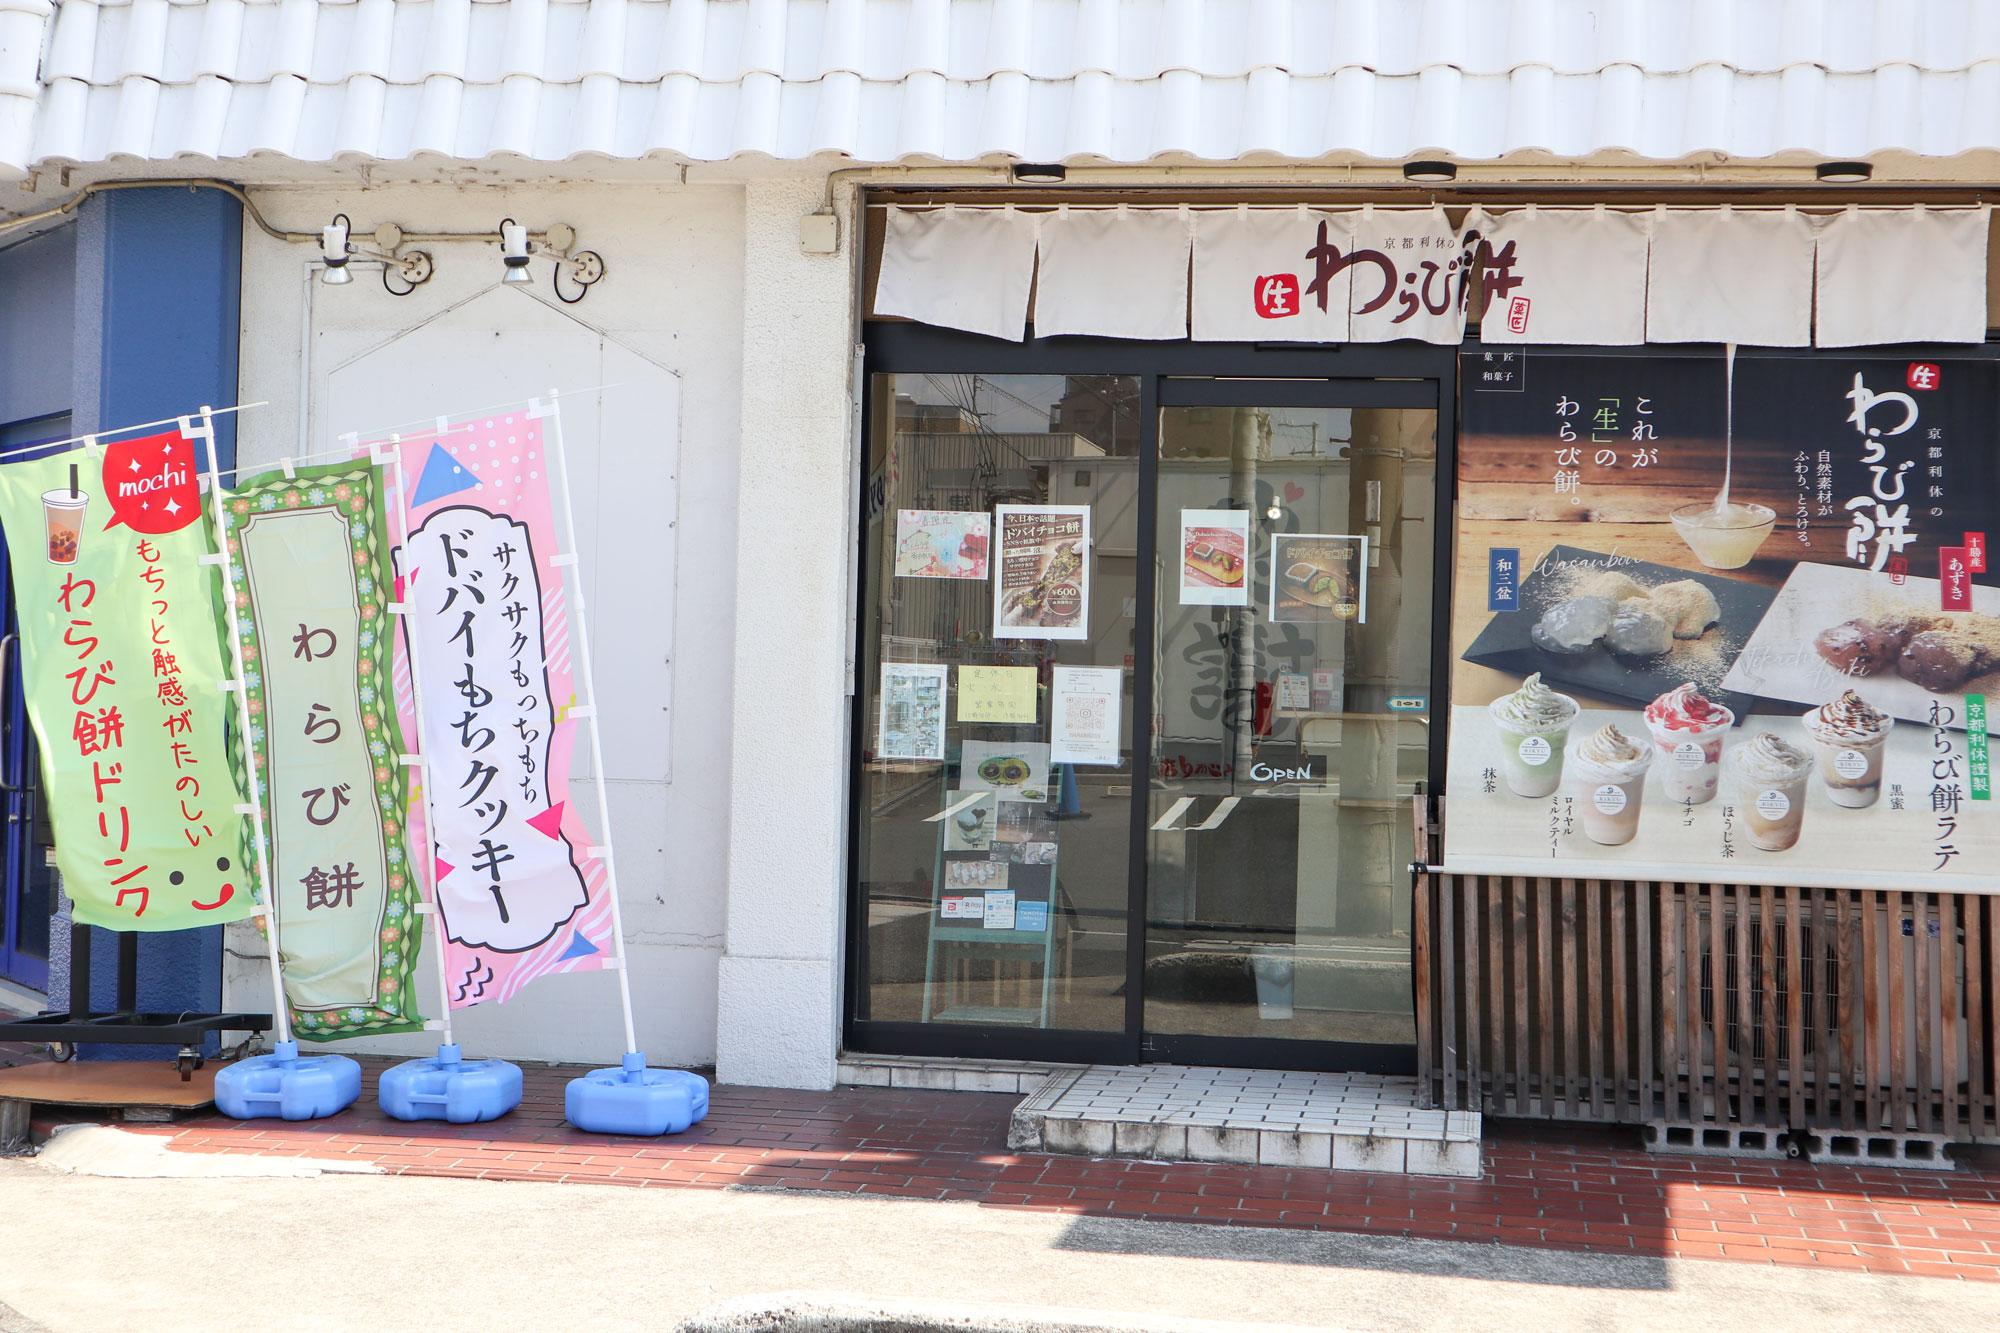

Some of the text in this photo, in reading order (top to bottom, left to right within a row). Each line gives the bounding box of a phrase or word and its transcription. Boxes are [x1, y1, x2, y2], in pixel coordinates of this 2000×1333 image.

[1384, 236, 1455, 250] 京都利休の
[1262, 278, 1293, 315] 生
[1483, 371, 1514, 381] 和菓子
[1911, 365, 1936, 389] 生
[1553, 395, 1581, 505] わらび餅。
[1592, 398, 1620, 466] 「生」の
[1631, 396, 1658, 467] これが
[119, 461, 187, 498] mochi
[1794, 450, 1811, 548] ふわり、とろける。
[1816, 450, 1833, 516] 自然素材が
[1845, 371, 1919, 574] わらび餅
[1927, 428, 1943, 517] 京都利休の
[1495, 558, 1513, 601] 和三盆
[1949, 557, 1965, 601] あずき
[137, 538, 212, 847] もちっと触感がたのしい
[492, 541, 541, 804] サクサクもっちもち
[58, 572, 150, 918] わらび餅ドリンク
[436, 528, 516, 924] ドバイもちクッキー
[1968, 703, 1989, 792] 京都利休謹製
[292, 622, 364, 911] わらび餅
[1482, 767, 1497, 793] 抹茶
[1890, 784, 1905, 810] 黒蜜
[1928, 700, 1964, 871] わらび餅ラテ
[1549, 796, 1561, 858] ミルクティー
[1562, 796, 1574, 836] ロイヤル
[1682, 796, 1695, 827] イチゴ
[1720, 805, 1736, 859] ほうじ茶
